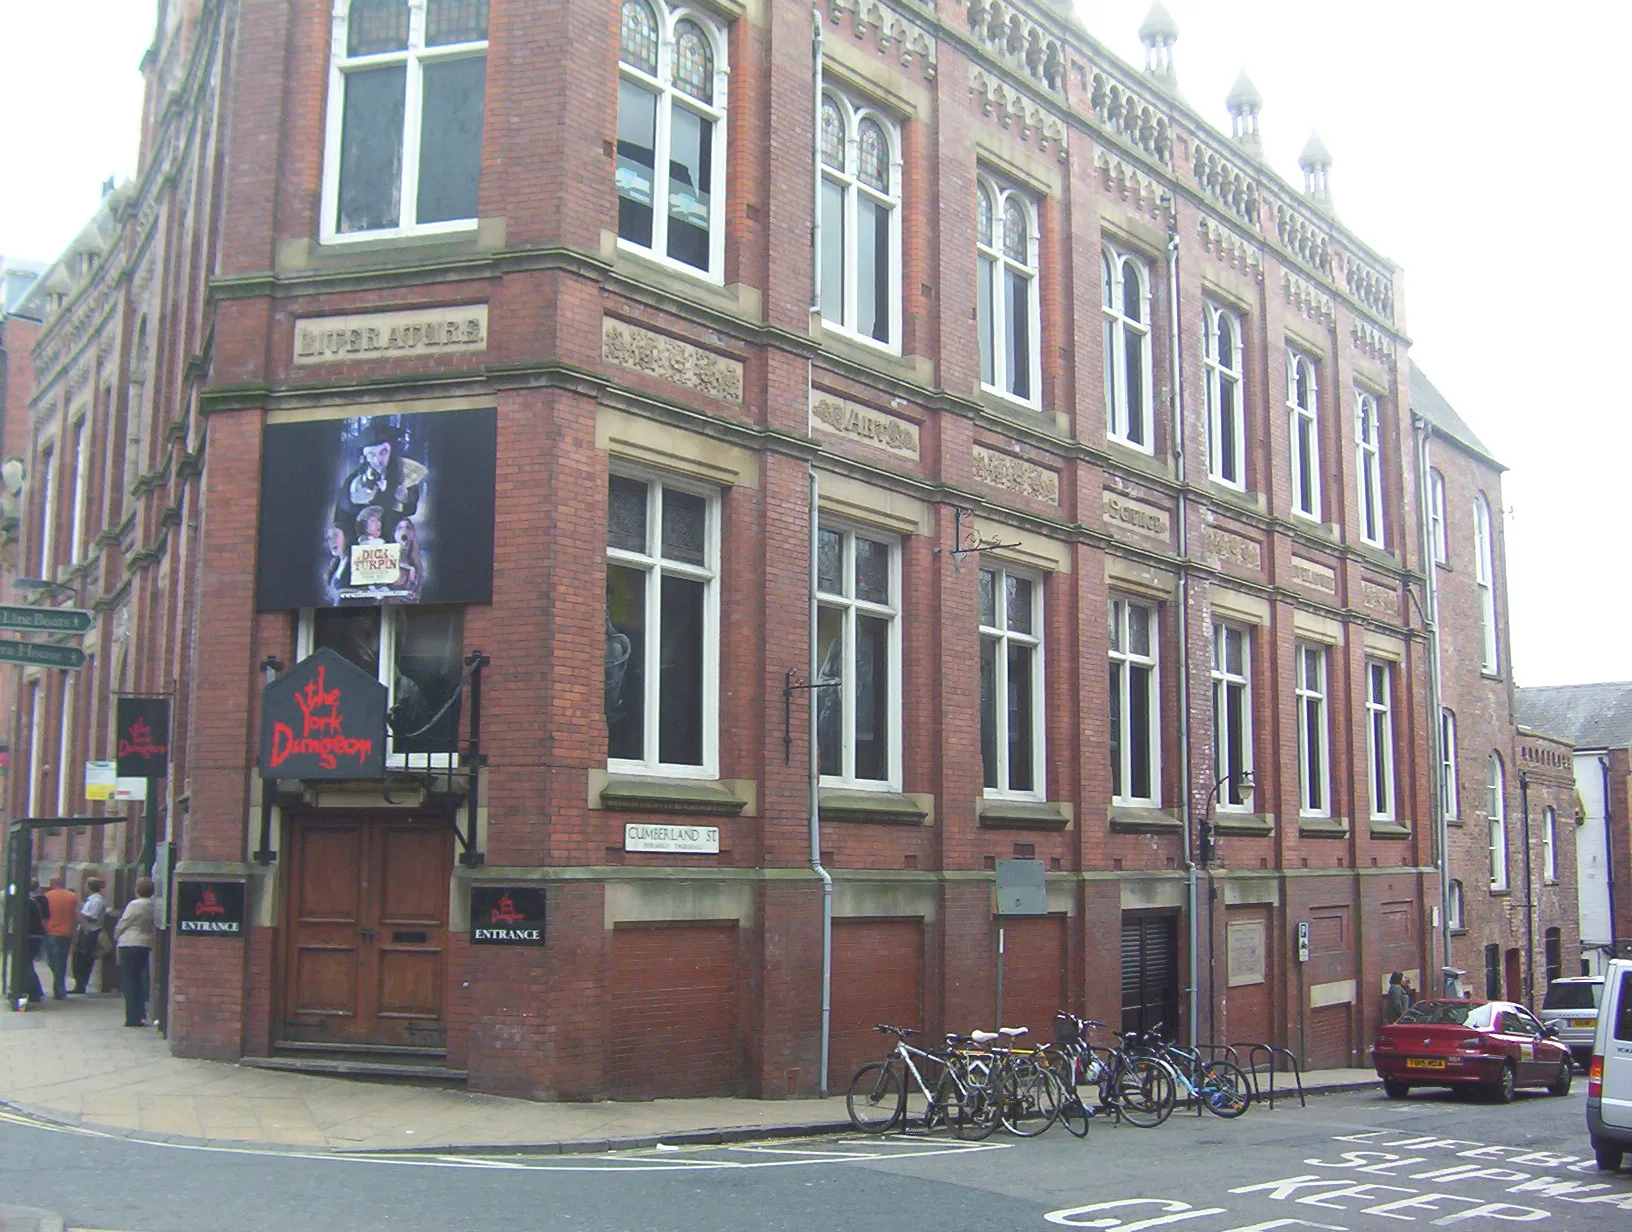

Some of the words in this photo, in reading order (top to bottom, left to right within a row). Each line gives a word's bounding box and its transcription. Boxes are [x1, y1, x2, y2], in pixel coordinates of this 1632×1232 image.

[297, 317, 485, 357] LITERATURE
[362, 548, 389, 560] DICK
[354, 558, 398, 571] TURPIN
[293, 691, 344, 737] York
[269, 720, 372, 769] Dungeon
[628, 826, 700, 842] CUMBERLAND
[181, 920, 239, 932] ENTRANCE
[475, 928, 540, 940] ENTRANCE
[1227, 1175, 1552, 1226] KEEP
